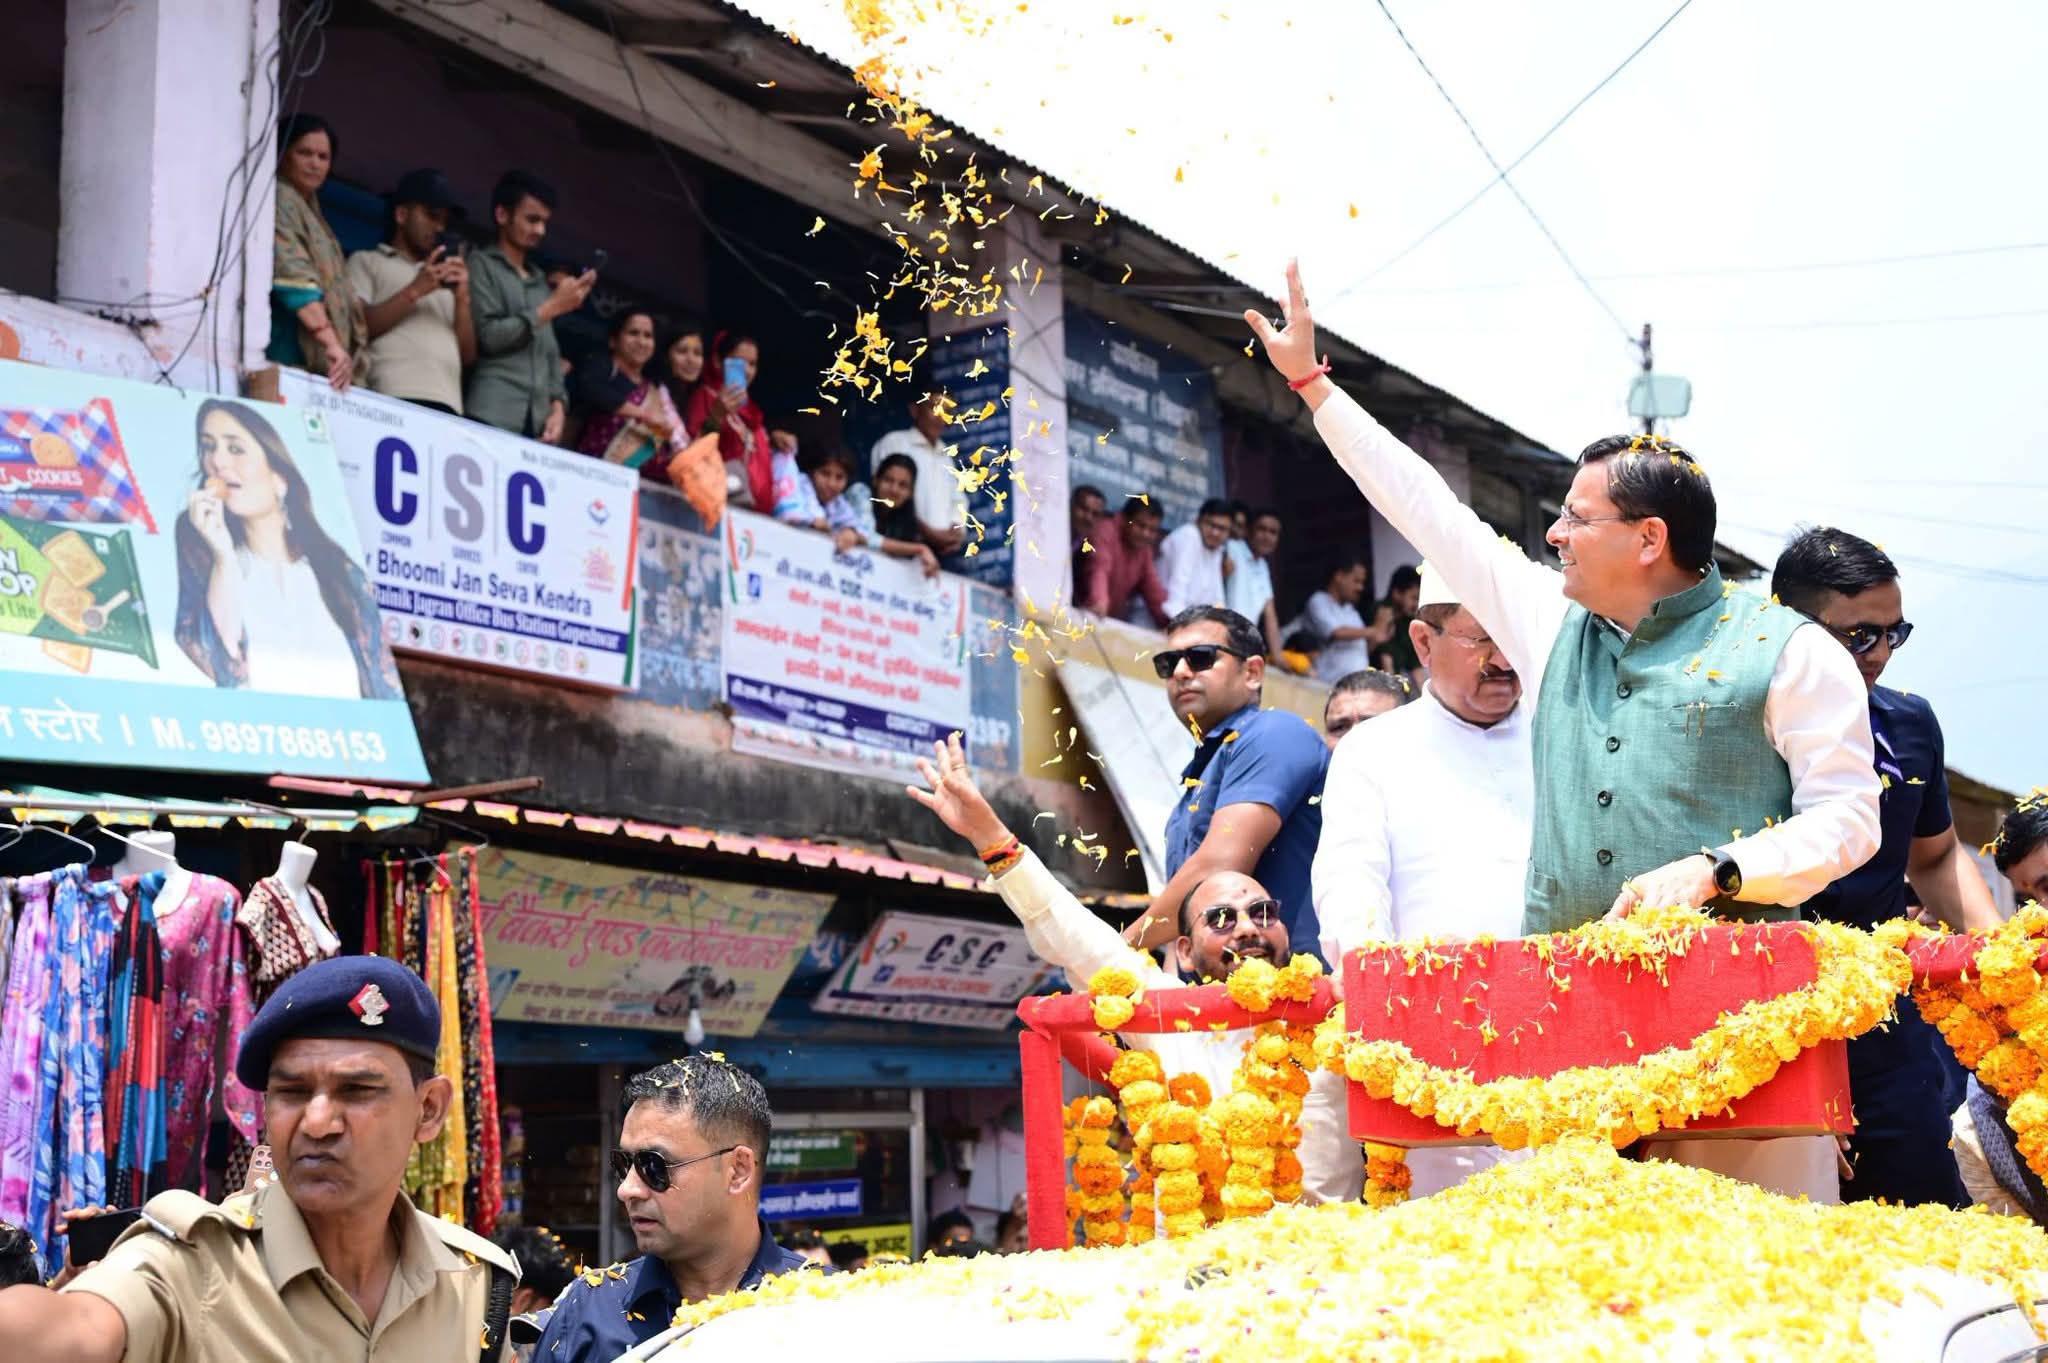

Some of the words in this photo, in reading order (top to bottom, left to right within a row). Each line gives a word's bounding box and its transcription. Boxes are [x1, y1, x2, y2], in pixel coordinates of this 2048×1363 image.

[377, 548, 446, 588] Bhoomi
[451, 564, 483, 595] Jan
[488, 571, 529, 604] Seva
[533, 580, 593, 618] Kendra
[19, 697, 103, 745] स्टोर
[150, 715, 197, 751] M.
[200, 719, 387, 763] 9897868153
